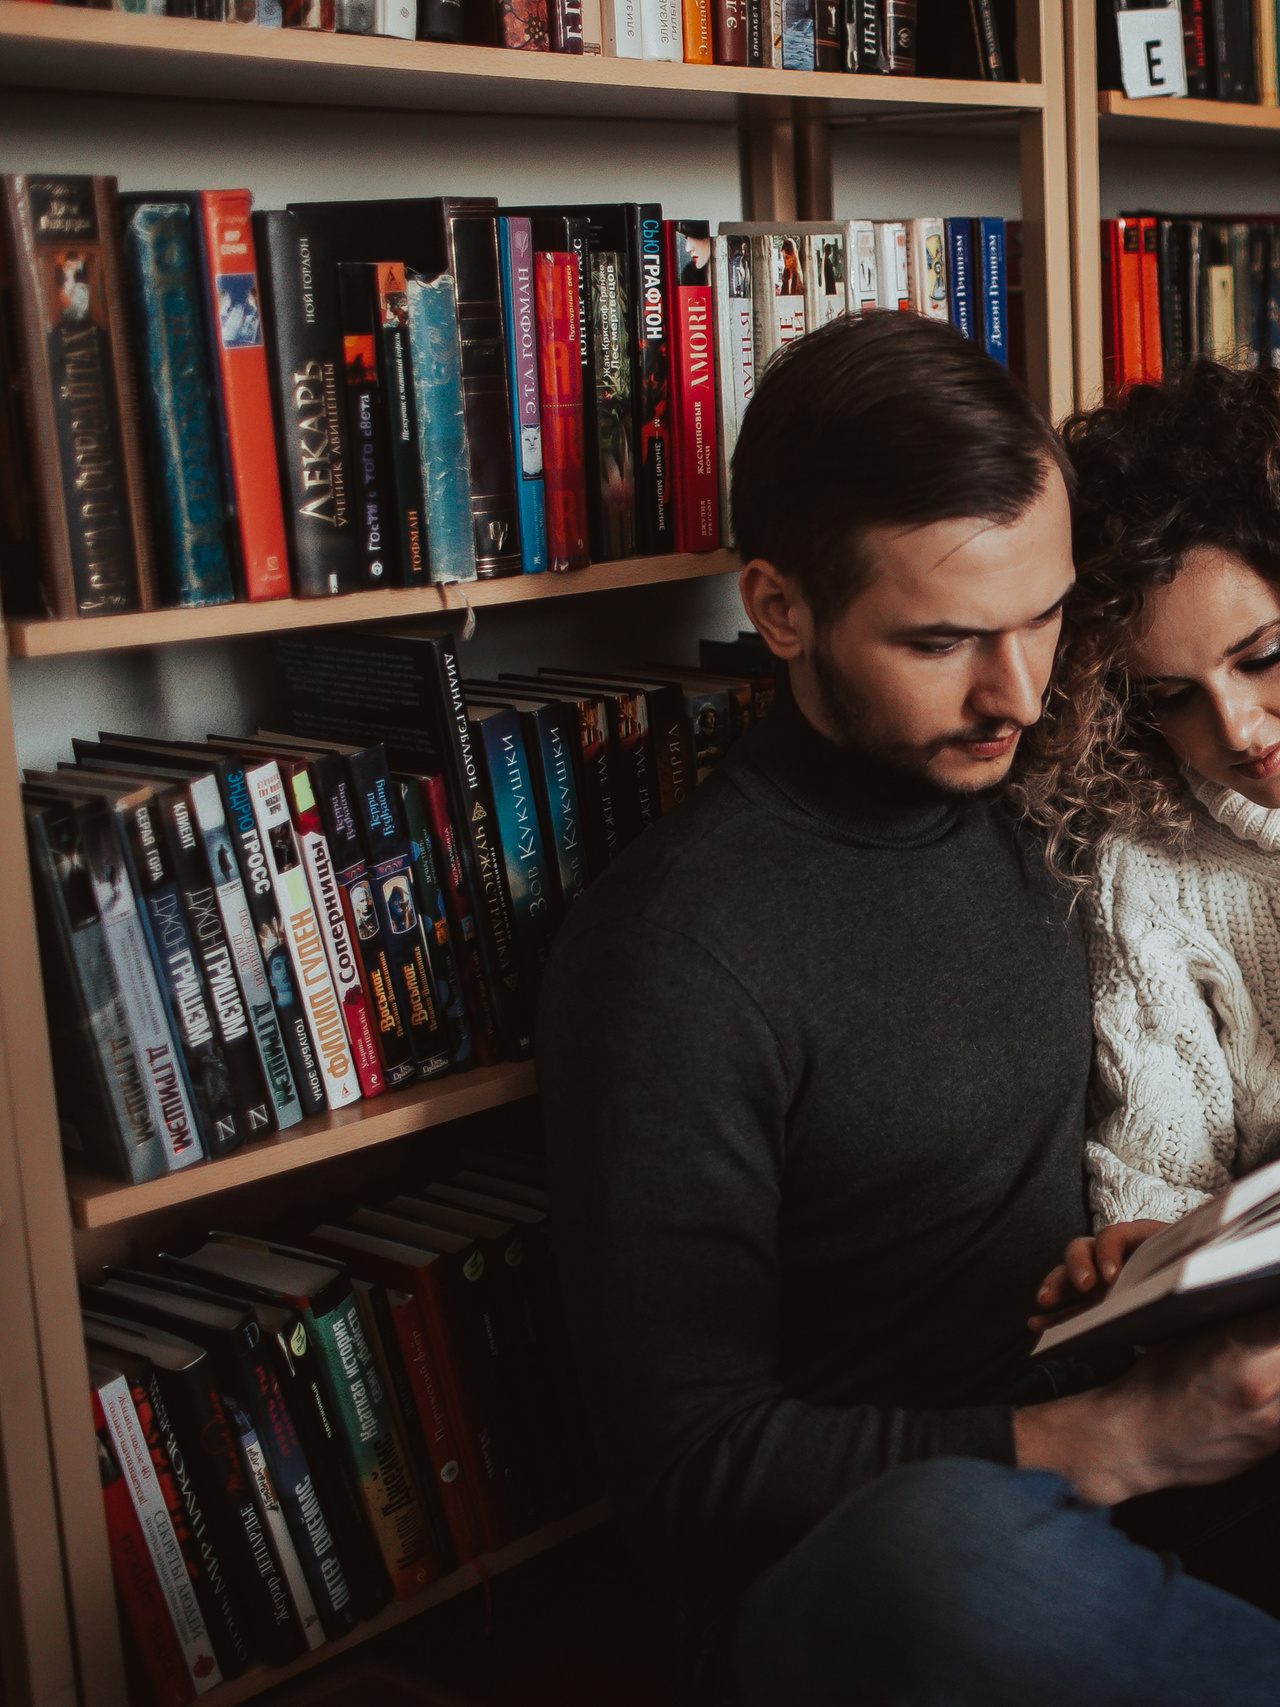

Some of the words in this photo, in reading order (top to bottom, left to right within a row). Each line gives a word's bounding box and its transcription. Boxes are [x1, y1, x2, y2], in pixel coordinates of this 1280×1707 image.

[752, 5, 760, 57] ЭЛИЗАБЕТ
[300, 237, 313, 287] ГОРДОН
[573, 237, 584, 291] ГРАСС
[642, 219, 659, 253] СЬЮ
[565, 264, 574, 287] реки
[597, 263, 607, 303] Гранже
[607, 264, 619, 341] мертвецов
[643, 253, 663, 339] ГРАФТОН
[518, 266, 532, 358] ГОФМАН
[566, 290, 576, 341] Пурпурные
[600, 303, 610, 376] Жан-Кристоф
[688, 296, 710, 389] AMORE
[609, 342, 620, 371] Лес
[740, 312, 753, 399] ЛУНЬЯ
[324, 362, 344, 454] АВИЦЕННЫ
[695, 400, 704, 475] ЖАСМИНОВЫЕ
[654, 442, 662, 477] ЗНАЧИТ
[330, 461, 348, 527] УЧЕНИК
[656, 479, 665, 531] МОЛЧАНИЕ
[407, 510, 422, 571] ГОФМАН
[444, 651, 463, 711] ДИАНА
[456, 713, 478, 789] ГЭБЛДОН
[667, 723, 686, 802] ОПРЯД
[173, 801, 196, 851] КЛИЕНТ
[225, 768, 256, 832] ЭНДРЮ
[241, 828, 271, 896] ГРОСС
[331, 796, 345, 834] Терри
[366, 791, 381, 829] Терри
[134, 806, 154, 847] СЕРАЯ
[146, 848, 164, 881] ГОРА
[152, 890, 188, 955] ДЖОН
[186, 882, 223, 952] ДЖОН
[310, 839, 355, 984] Соперницы
[475, 825, 509, 969] ЧУЖЕСТРАНКА
[232, 931, 251, 973] ШАНС
[238, 908, 267, 988] ПОСЛЕДНИЙ
[288, 907, 326, 987] ГУДЕН
[168, 947, 211, 1048] ГРИШЭМ
[204, 944, 246, 1042] ГРИШЭМ
[293, 1018, 314, 1070] ГОЛУБАЯ
[307, 1069, 323, 1101] ЗОНА
[308, 986, 351, 1079] ФИЛИП
[357, 1007, 376, 1064] ГРЮНЕВАЛЬД
[330, 1317, 361, 1378] история
[346, 1306, 372, 1365] убийств
[311, 1381, 332, 1438] ОДЕРЖИМЫЙ
[348, 1378, 378, 1441] Краткая
[364, 1366, 383, 1402] семи
[105, 1400, 124, 1440] только
[129, 1432, 145, 1465] после
[139, 1464, 151, 1479] 40
[162, 1432, 205, 1536] ПАУКОВ
[366, 1430, 413, 1516] Джеймс
[153, 1509, 183, 1580] СЕКРЕТЫ
[240, 1502, 272, 1577] ДЕПАРДЬЕ
[292, 1474, 334, 1556] ДЖЕЙМС
[199, 1540, 225, 1593] МИР
[319, 1555, 351, 1610] ПИТЕР
[266, 1576, 289, 1624] Жерар
